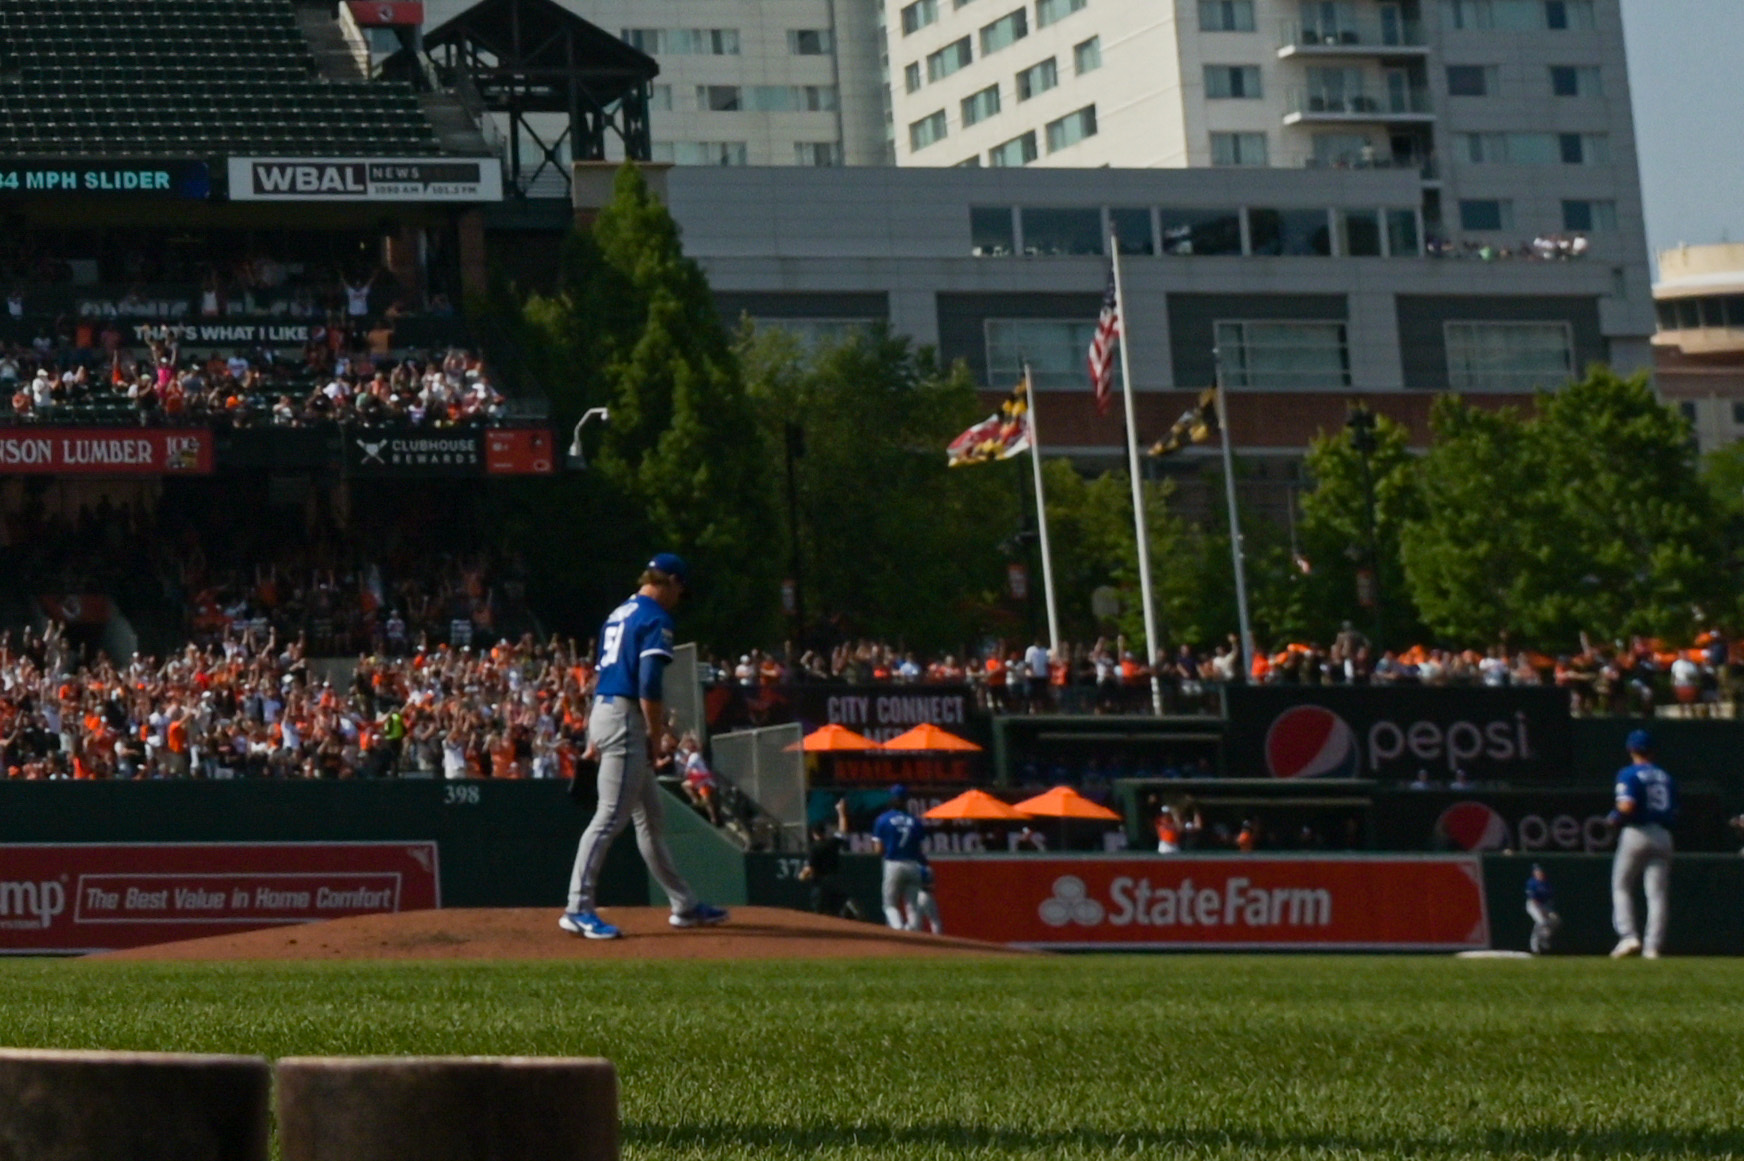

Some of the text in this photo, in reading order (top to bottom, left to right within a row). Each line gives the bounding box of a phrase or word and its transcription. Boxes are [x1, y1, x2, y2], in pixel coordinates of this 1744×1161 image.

[26, 171, 77, 189] MPH
[84, 171, 170, 189] SLIDER
[256, 166, 365, 192] WBAL
[372, 166, 420, 180] NEWS
[201, 326, 255, 340] WHAT
[259, 326, 265, 340] I
[269, 326, 308, 340] LIKE
[62, 439, 153, 464] LUMBER
[392, 439, 476, 452] CLUBHOUSE
[392, 453, 477, 465] REWARDS
[827, 696, 965, 724] CITY CONNECT
[1368, 710, 1529, 772] pepsi
[443, 784, 480, 805] 398
[776, 858, 809, 879] 37
[87, 887, 119, 909] The
[124, 887, 168, 909] Best
[173, 887, 226, 909] Value
[231, 887, 250, 909] in
[256, 887, 310, 909] Home
[315, 886, 392, 909] Comfort
